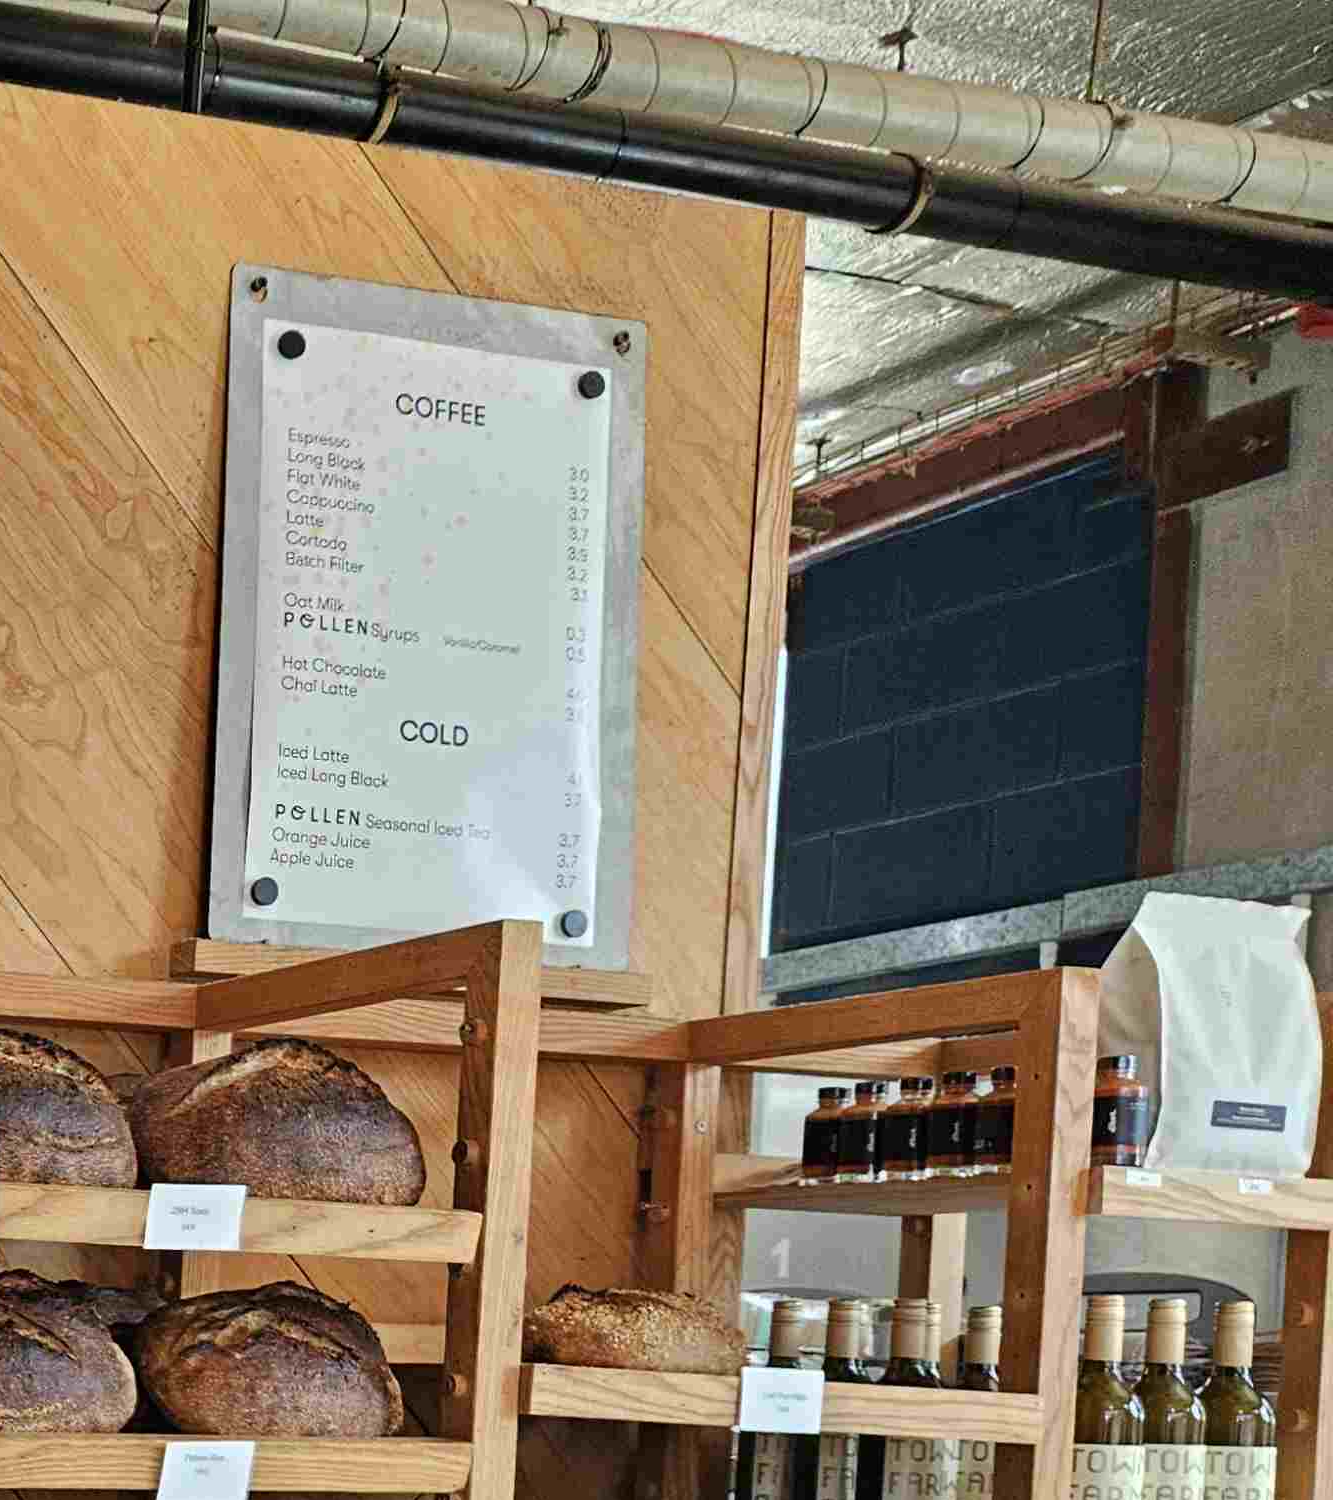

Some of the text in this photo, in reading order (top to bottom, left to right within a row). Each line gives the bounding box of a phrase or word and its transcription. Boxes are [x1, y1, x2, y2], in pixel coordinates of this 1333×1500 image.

[395, 393, 486, 427] COFFEE
[288, 427, 350, 449] Espresso
[287, 447, 366, 471] Long Black
[286, 468, 361, 492] Flat White
[285, 489, 375, 515] Cappuccino
[286, 509, 324, 529] Latte
[285, 530, 348, 553] Cortado
[285, 551, 365, 574] Batch Filter
[283, 591, 345, 613] Oat Milk
[284, 611, 420, 644] POLLEN Syrups
[282, 655, 387, 680] Hot Chocolate
[280, 675, 358, 698] Chai Latte
[399, 719, 469, 747] COLD
[278, 743, 350, 764] Iced Latte
[276, 763, 389, 789] Iced Long Black
[274, 803, 361, 826] POLLEN
[364, 813, 431, 834] Seasonal
[434, 820, 463, 838] Iced
[271, 827, 371, 849] Orange Juice
[269, 847, 355, 869] Apple Juice
